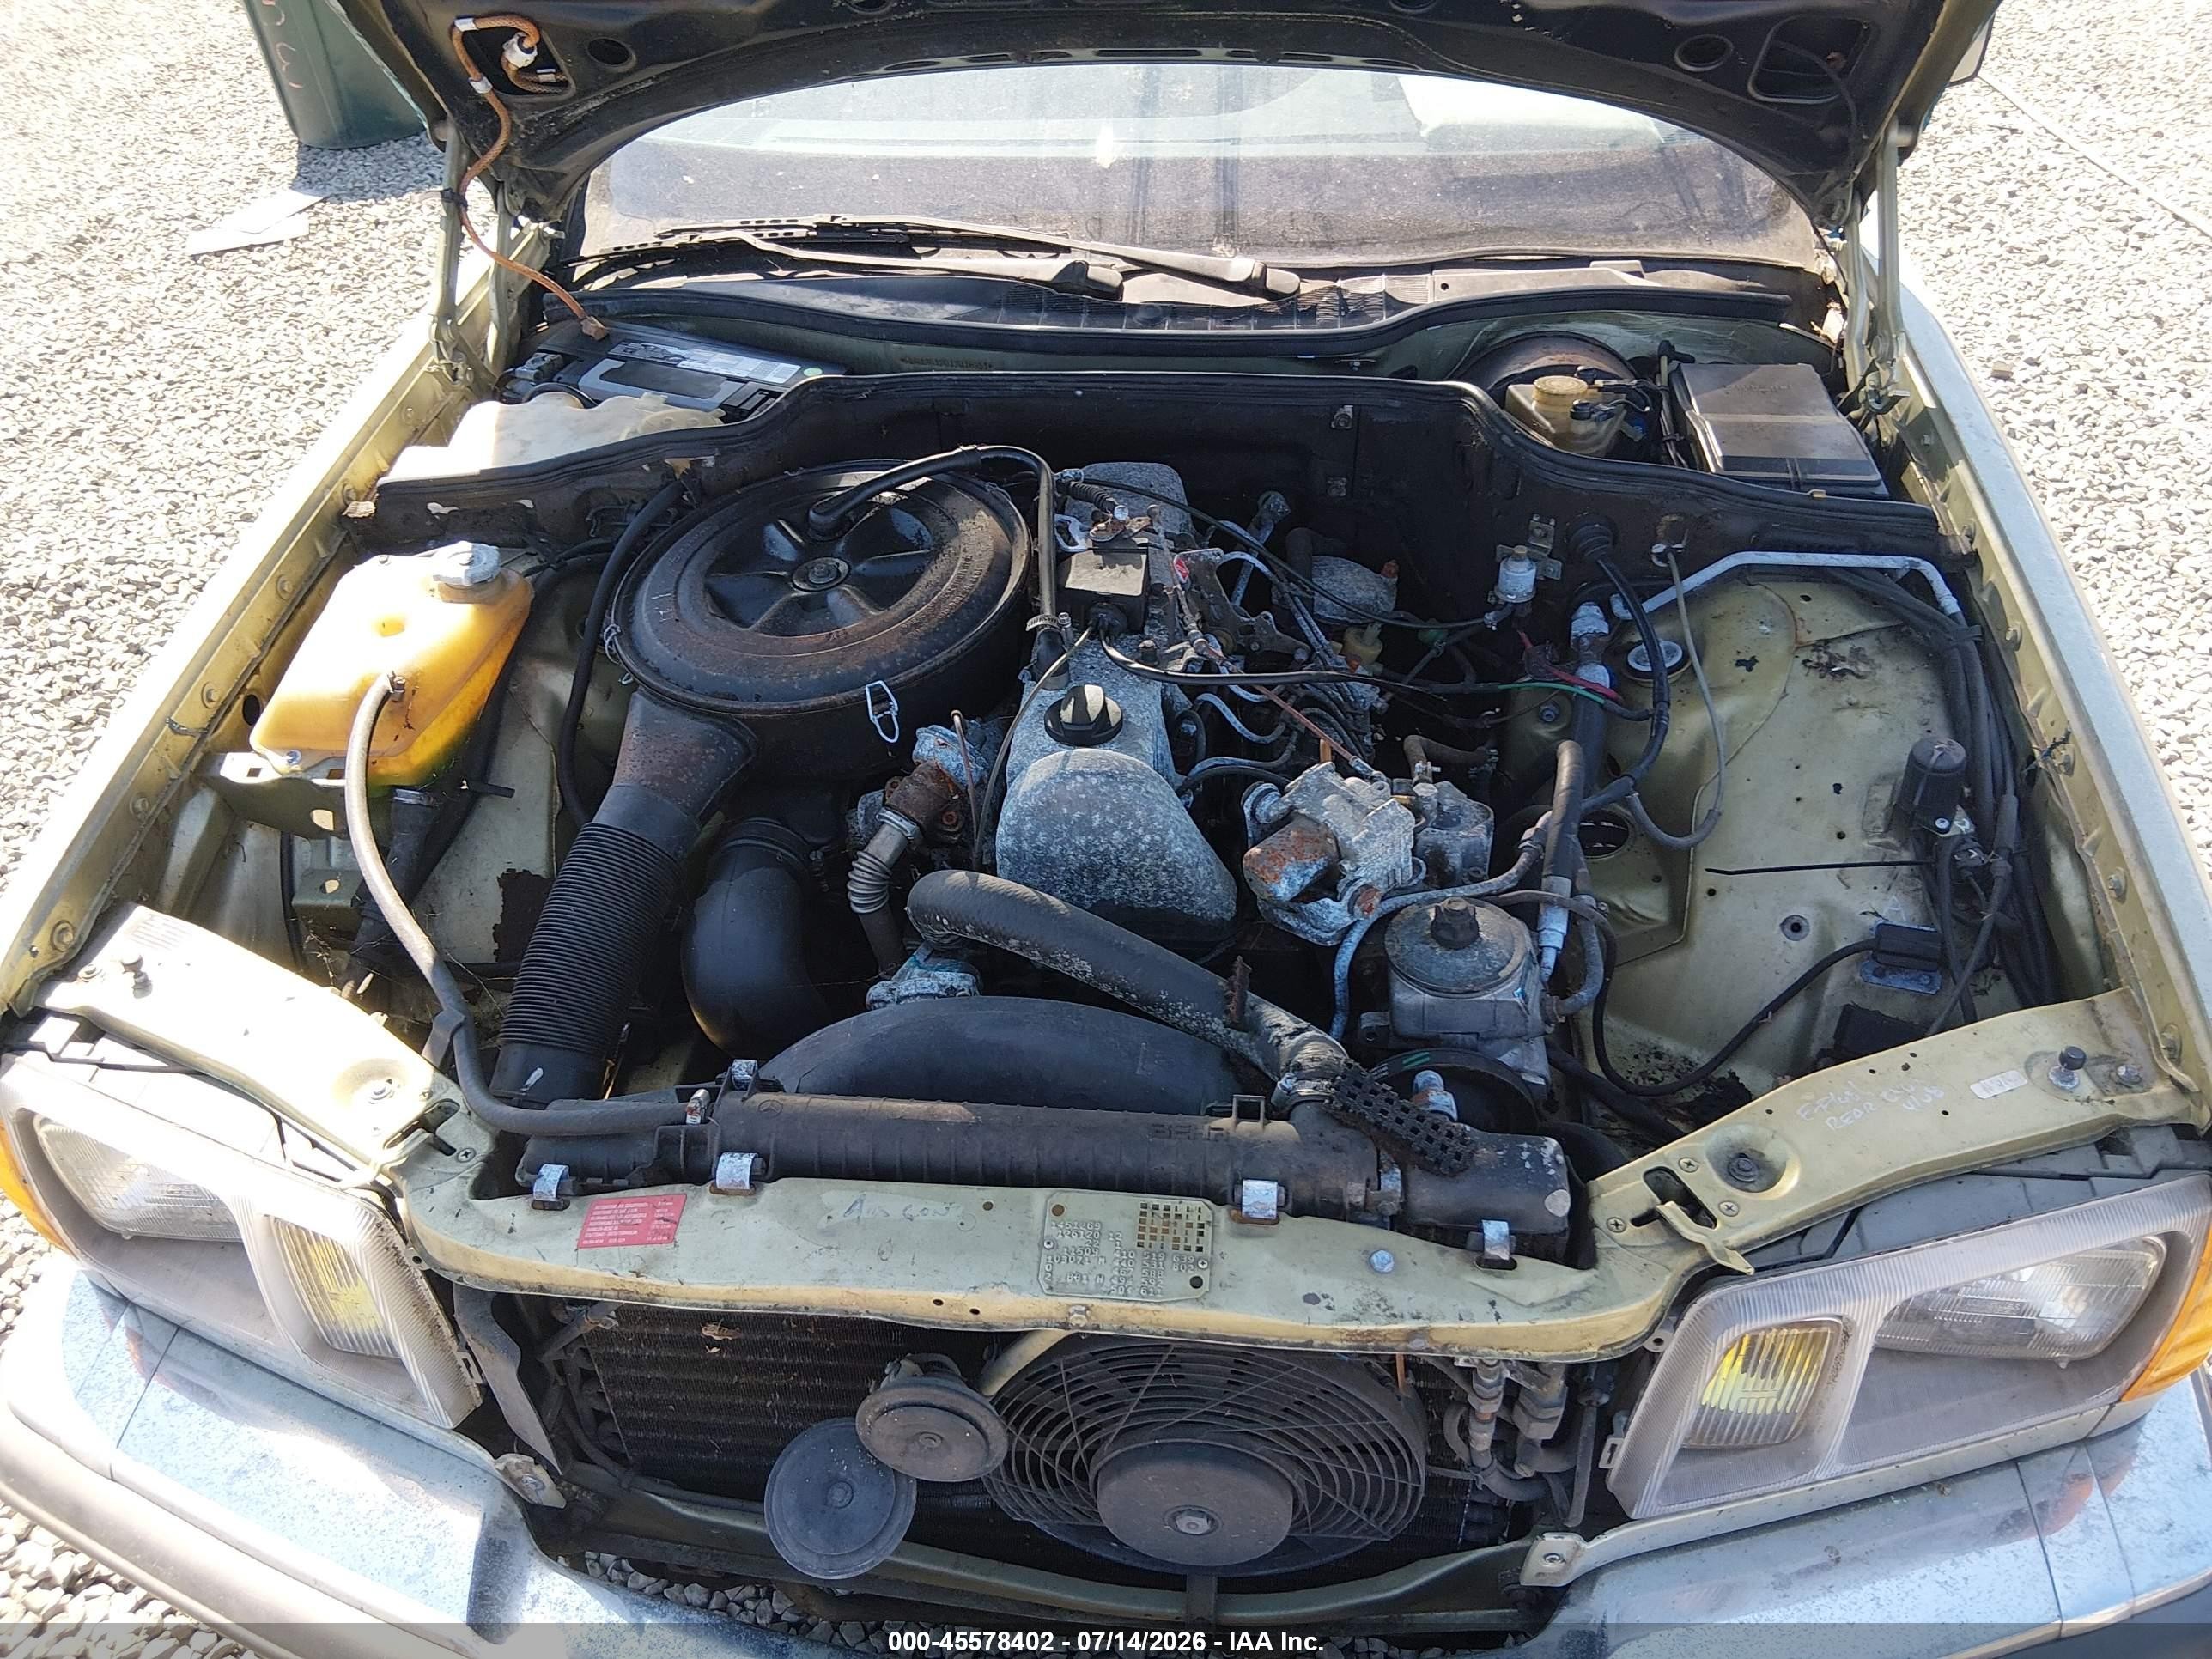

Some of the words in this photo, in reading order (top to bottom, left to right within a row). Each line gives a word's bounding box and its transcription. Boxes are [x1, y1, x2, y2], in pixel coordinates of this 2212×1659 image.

[1085, 1239, 1100, 1248] 22
[1143, 1252, 1166, 1261] 519
[1173, 1255, 1196, 1264] 639
[1142, 1261, 1165, 1270] 531
[1142, 1269, 1165, 1279] 588
